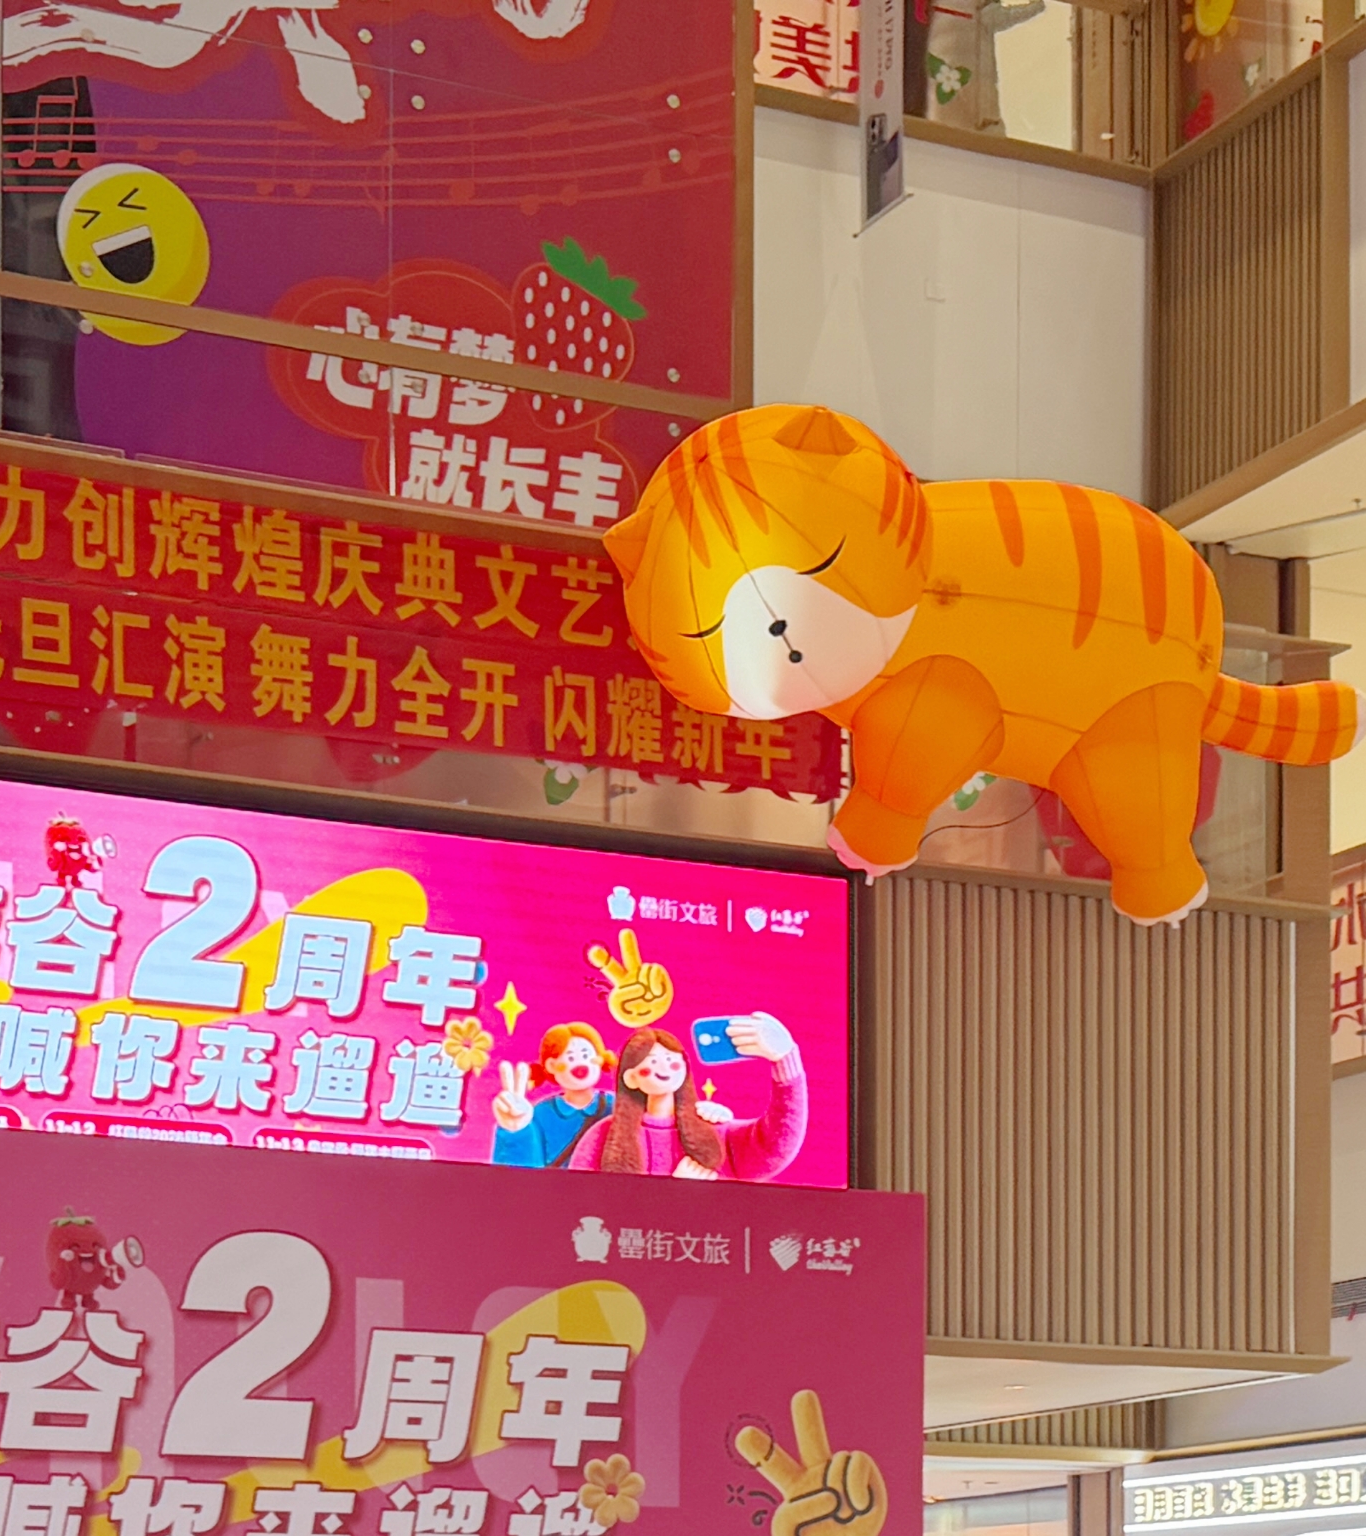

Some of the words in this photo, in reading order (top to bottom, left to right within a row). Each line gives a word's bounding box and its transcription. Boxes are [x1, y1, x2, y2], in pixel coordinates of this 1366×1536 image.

[402, 428, 623, 526] 就长丰
[249, 624, 520, 748] 舞力全开
